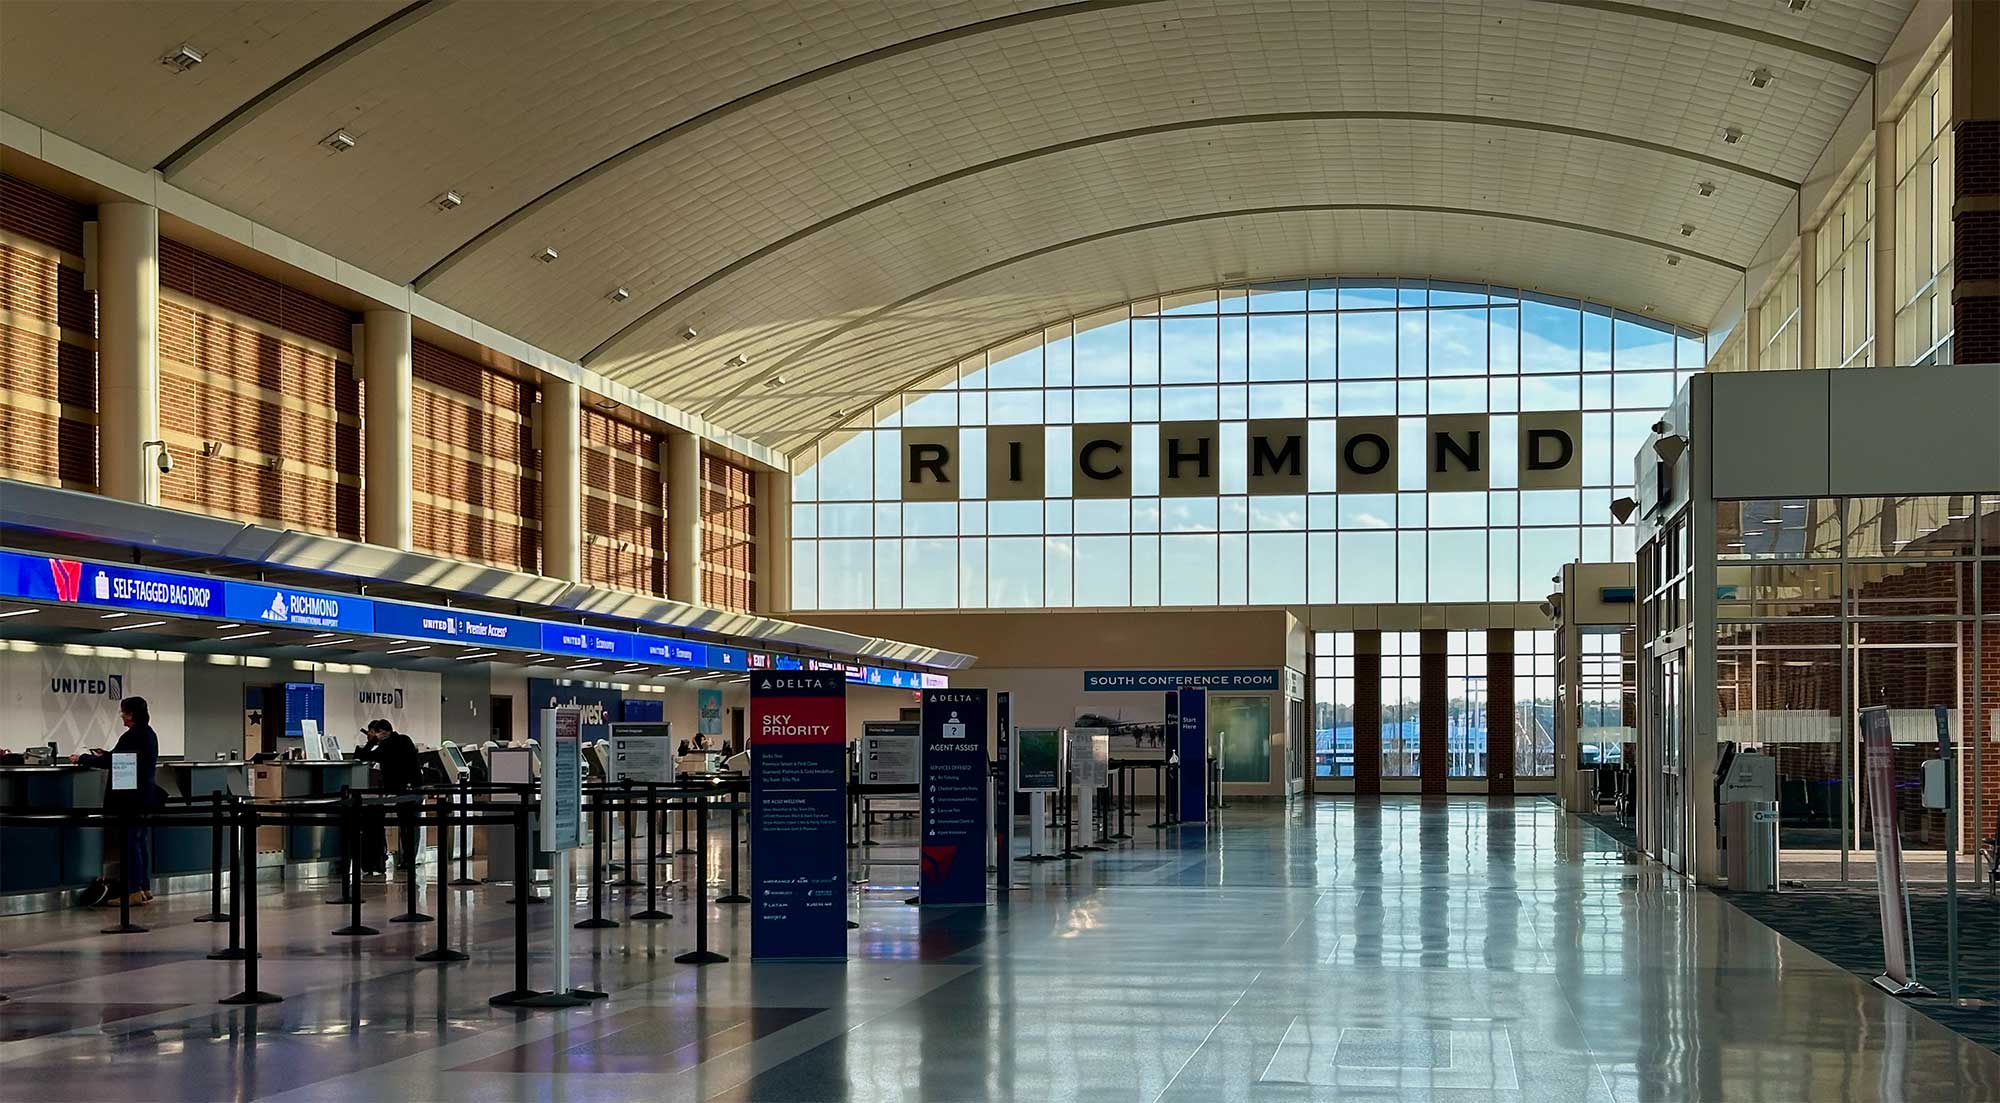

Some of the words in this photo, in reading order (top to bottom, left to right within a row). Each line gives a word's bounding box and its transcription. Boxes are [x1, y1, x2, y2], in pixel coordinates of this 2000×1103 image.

[908, 428, 1574, 484] RICHMOND
[114, 578, 170, 603] SELF-TAGGED
[170, 585, 187, 605] BAG
[188, 587, 210, 607] DROP
[290, 595, 338, 617] RICHMOND
[423, 619, 447, 631] UNITED
[466, 621, 487, 636] Premier
[51, 678, 106, 694] UNITED
[776, 679, 823, 689] DELTA
[1090, 676, 1135, 686] SOUTH
[1138, 675, 1230, 686] CONFERENCE
[1233, 675, 1273, 685] ROOM
[359, 691, 394, 704] UNITED
[939, 694, 972, 702] DELTA
[762, 714, 792, 725] SKY
[762, 725, 830, 736] PRIORITY
[929, 743, 954, 752] AGENT
[955, 743, 979, 752] ASSIST
